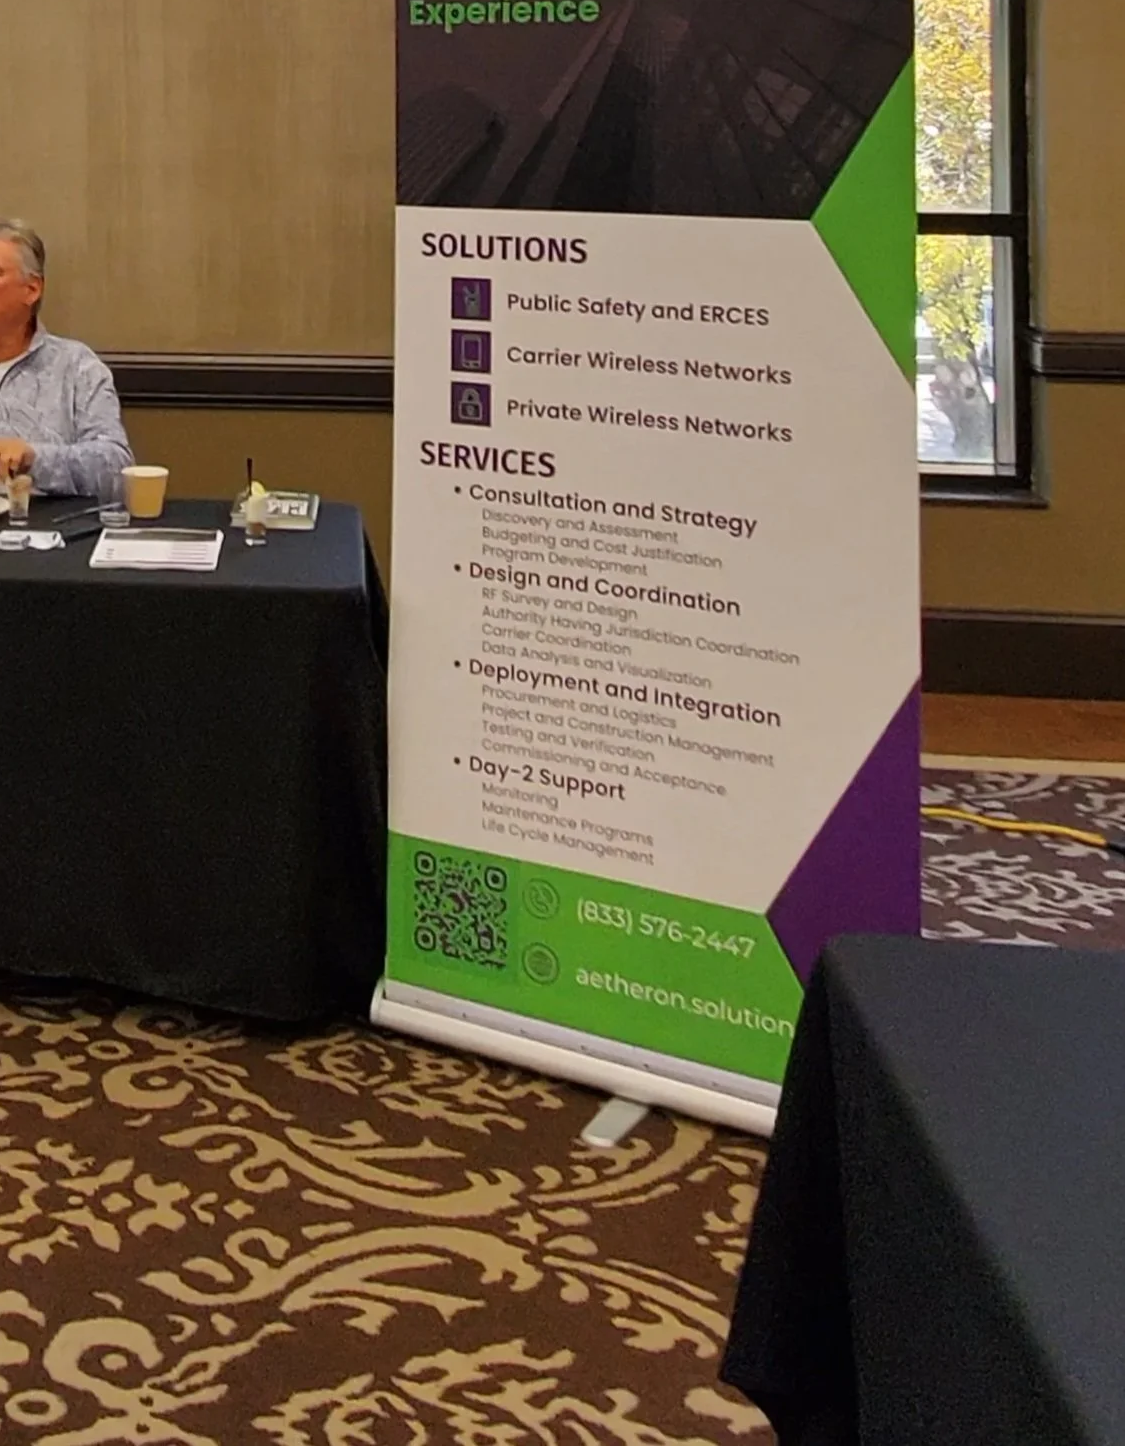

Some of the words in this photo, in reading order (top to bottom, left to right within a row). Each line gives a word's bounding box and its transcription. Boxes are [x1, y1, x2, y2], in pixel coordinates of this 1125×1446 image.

[421, 232, 588, 264] SOLUTIONS
[507, 293, 571, 314] Public
[578, 296, 645, 323] Safety
[652, 302, 693, 321] and
[700, 305, 769, 326] ERCES
[507, 346, 580, 368] Carrier
[587, 351, 678, 377] Wireless
[685, 359, 791, 385] Networks
[507, 399, 581, 421] Private
[588, 405, 678, 431] Wireless
[685, 415, 792, 442] Networks
[420, 441, 555, 478] SERVICES
[470, 484, 606, 514] Consultation
[612, 500, 654, 520] and
[661, 505, 757, 538] Strategy
[482, 508, 552, 529] Discovery
[556, 517, 584, 531] and
[589, 521, 678, 543] Assessment
[482, 526, 556, 549] Budgeting
[560, 536, 589, 550] and
[593, 539, 626, 554] Cost
[631, 545, 722, 569] Justification
[482, 544, 544, 563] Program
[549, 550, 647, 575] Development
[470, 562, 540, 589] Design
[547, 572, 588, 593] and
[595, 579, 740, 616] Coordination
[482, 587, 497, 599] RF
[502, 590, 550, 610] Survey
[554, 597, 583, 612] and
[587, 601, 638, 621] Design
[482, 606, 547, 626] Authority
[551, 615, 602, 636] Having
[606, 624, 692, 647] Jurisdiction
[696, 637, 800, 666] Coordination
[482, 623, 531, 640] Carrier
[535, 630, 632, 656] Coordination
[482, 641, 516, 657] Data
[520, 647, 580, 666] Analysis
[584, 657, 614, 672] and
[617, 661, 712, 689] Visualization
[470, 658, 600, 691] Deployment
[605, 680, 647, 703] and
[655, 688, 781, 727] Integration
[482, 685, 576, 711] Procurement
[580, 702, 609, 717] and
[612, 708, 676, 729] Logistics
[482, 702, 531, 721] Project
[535, 712, 563, 727] and
[567, 716, 664, 746] Construction
[668, 734, 774, 767] Management
[482, 720, 533, 743] Testing
[537, 732, 566, 746] and
[569, 735, 655, 762] Verification
[470, 755, 534, 783] Day-2
[540, 769, 625, 801] Support
[482, 738, 595, 772] Commissioning
[599, 760, 629, 775] and
[634, 766, 727, 796] Acceptance
[482, 782, 558, 811] Monitoring
[482, 800, 576, 830] Maintenance
[581, 819, 653, 846] Programs
[482, 818, 505, 834] Life
[509, 824, 549, 842] Cycle
[554, 833, 654, 866] Management
[577, 899, 633, 935] (833)
[640, 913, 755, 958] 576-2447
